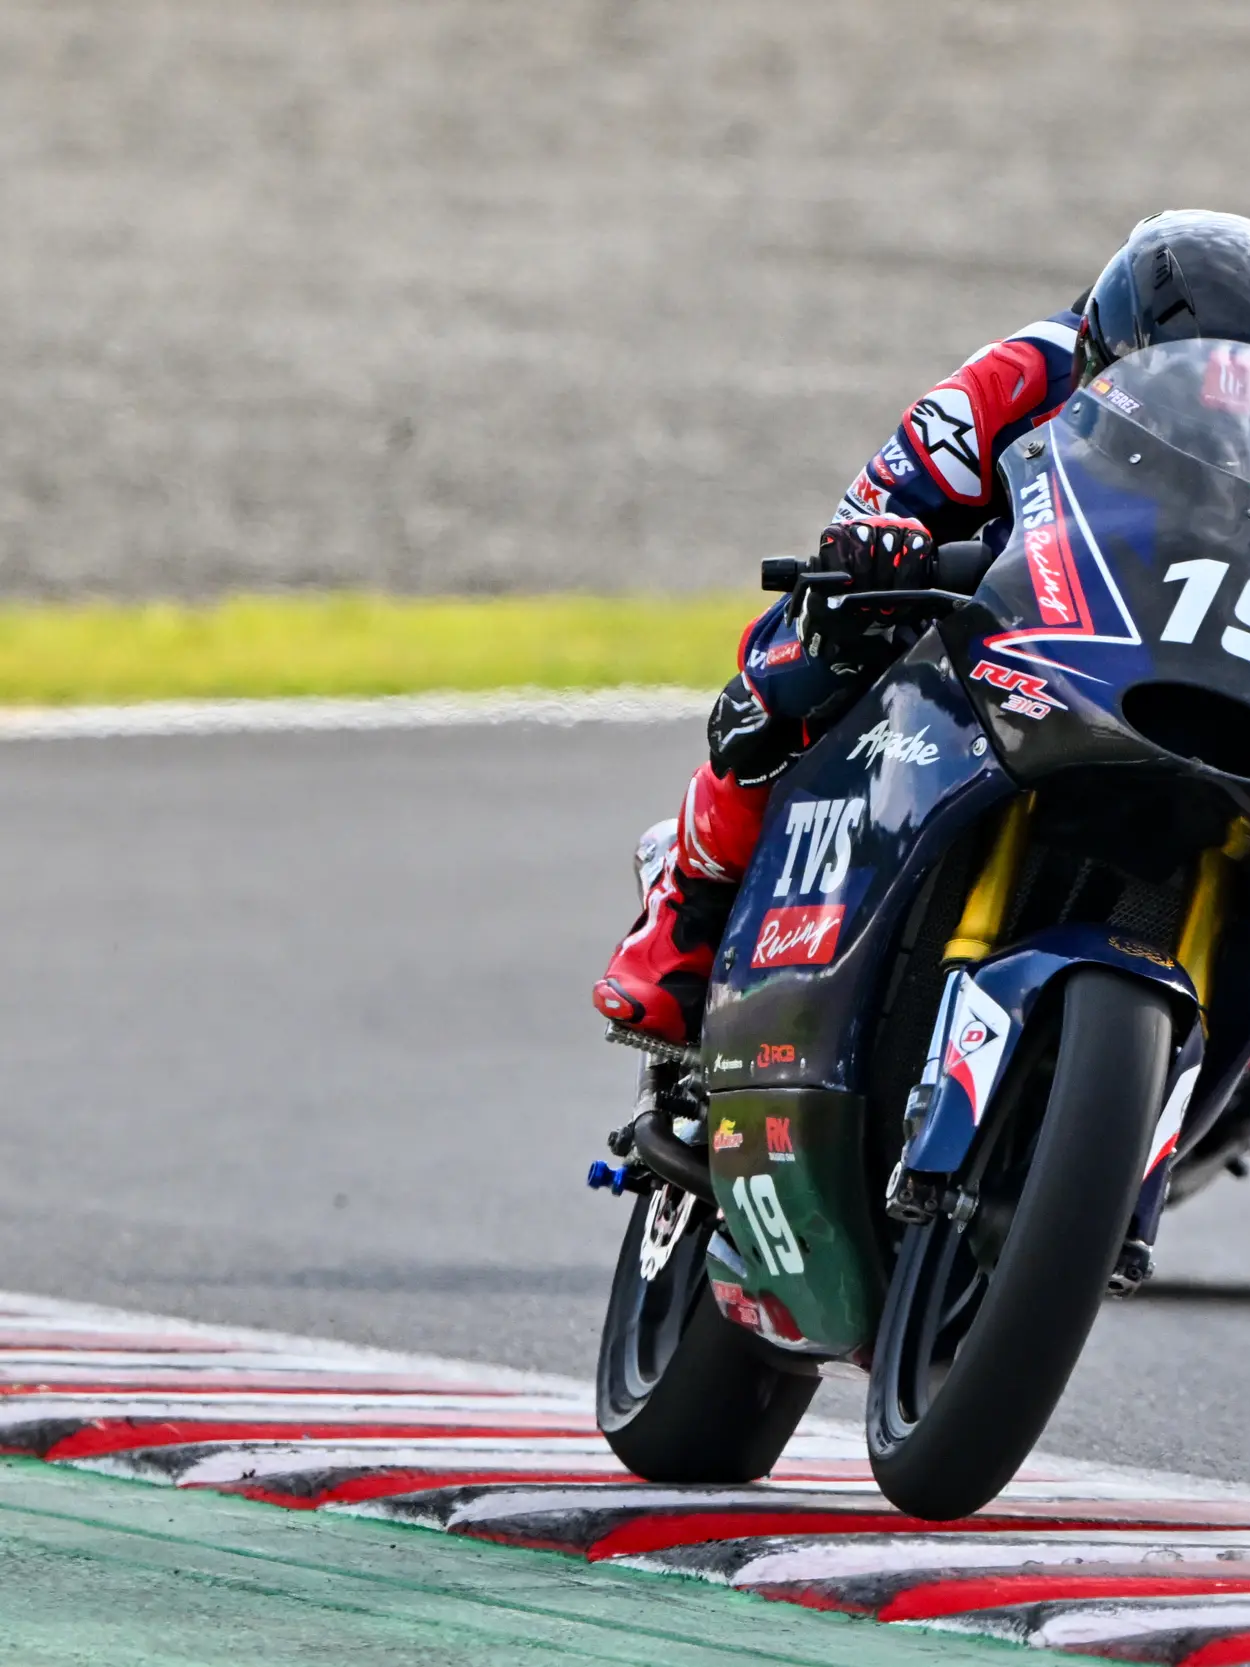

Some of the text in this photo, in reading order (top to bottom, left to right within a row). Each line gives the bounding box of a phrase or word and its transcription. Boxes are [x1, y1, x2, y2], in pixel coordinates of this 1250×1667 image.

[1106, 388, 1140, 414] PEREZ
[1020, 471, 1054, 530] TVS
[1025, 530, 1069, 622] Racing
[1000, 694, 1051, 720] 310
[846, 719, 940, 770] Apache
[773, 798, 866, 897] TVS
[753, 915, 840, 964] Racing
[765, 1116, 793, 1153] RK
[732, 1173, 804, 1276] 19
